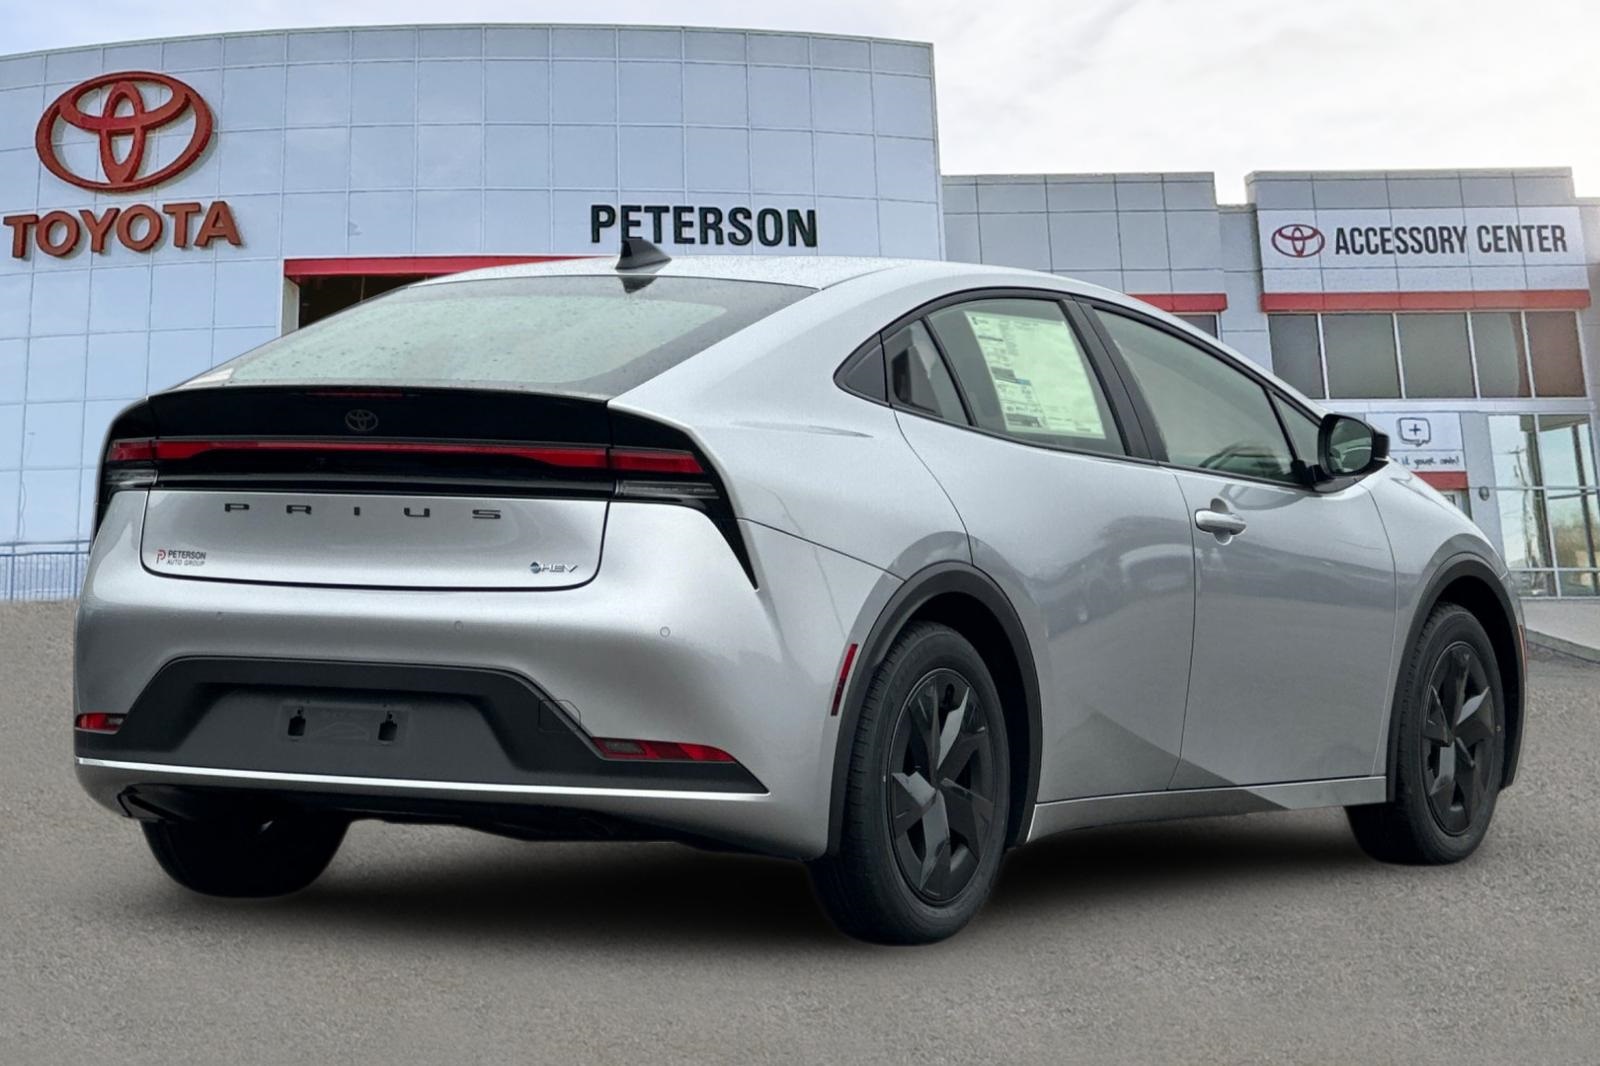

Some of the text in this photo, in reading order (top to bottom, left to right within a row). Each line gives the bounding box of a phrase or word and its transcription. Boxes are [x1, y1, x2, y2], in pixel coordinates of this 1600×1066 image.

[3, 201, 242, 258] TOYOTA
[591, 204, 818, 248] PETERSON
[1335, 225, 1568, 255] ACCESSORY CENTER
[224, 502, 501, 520] PRIUS
[168, 550, 206, 560] PETERSON
